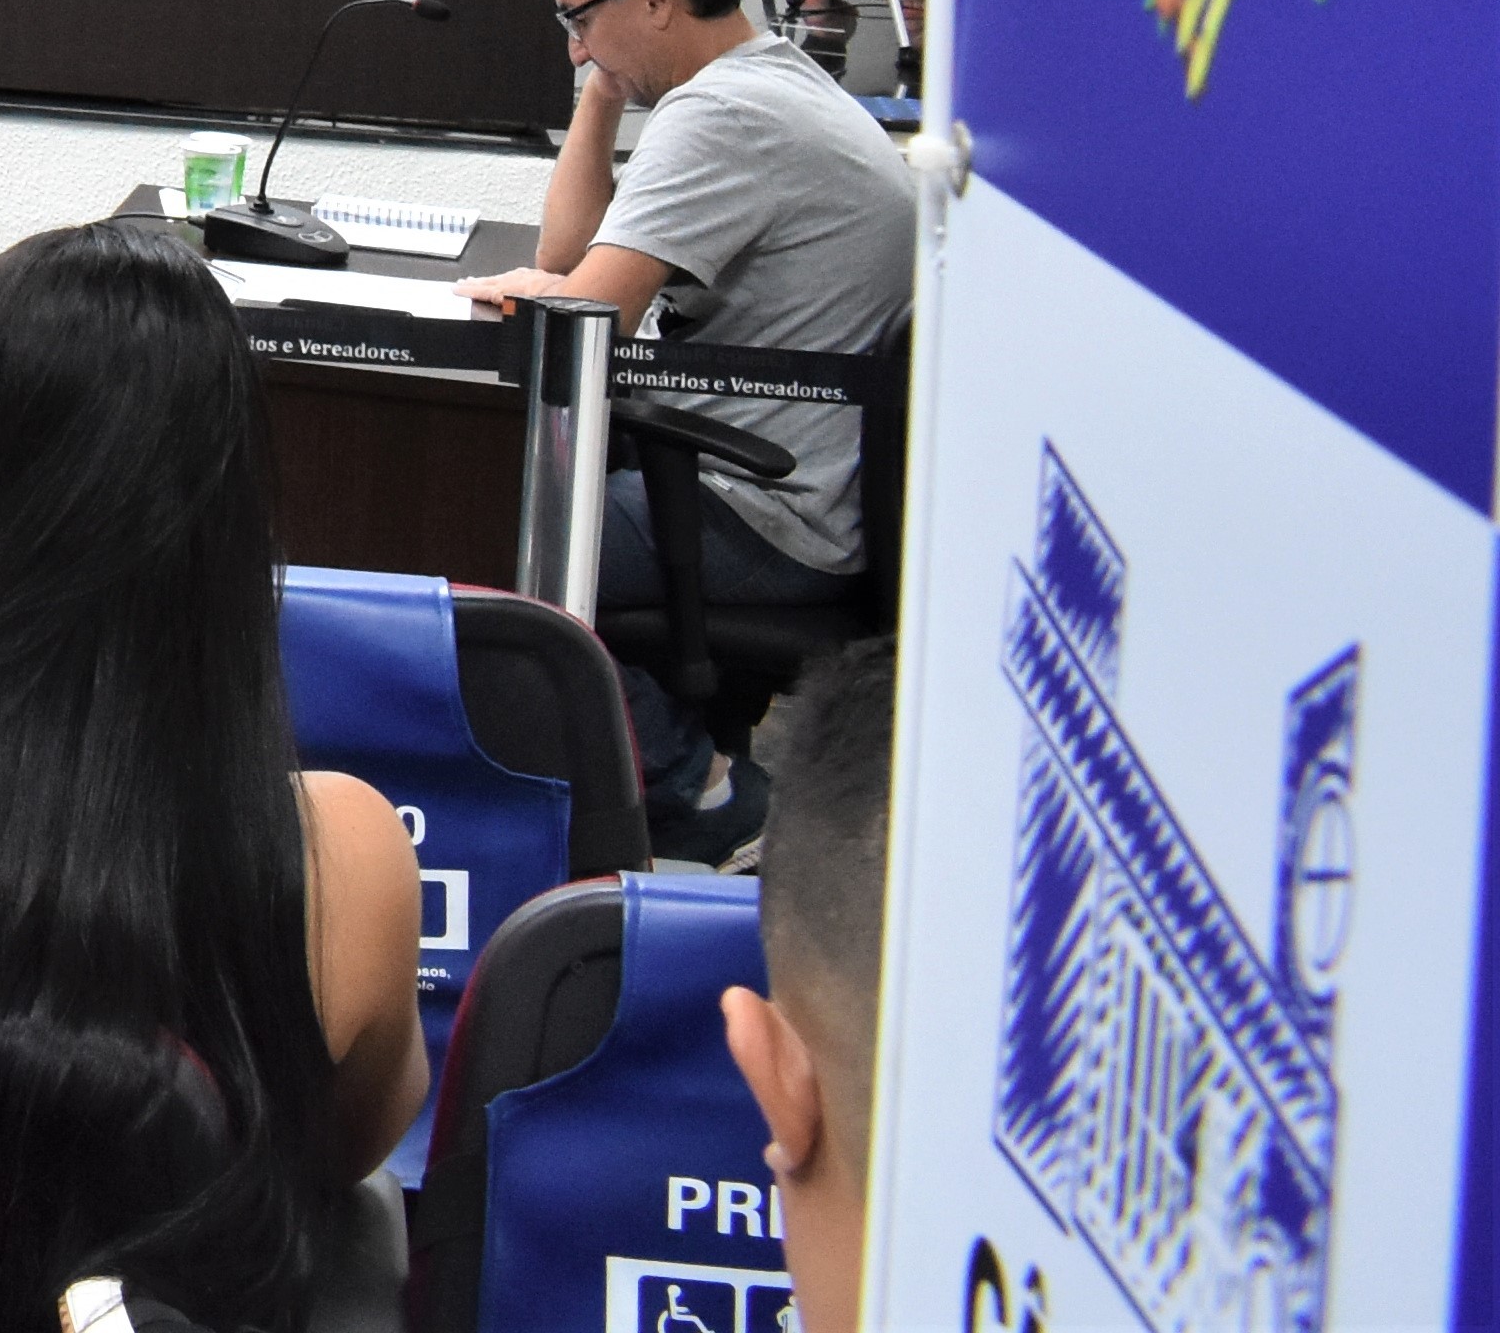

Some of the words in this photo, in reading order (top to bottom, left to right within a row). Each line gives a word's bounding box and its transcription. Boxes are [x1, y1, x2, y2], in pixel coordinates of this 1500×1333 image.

[282, 340, 294, 354] e
[298, 337, 415, 363] Vereadores.
[613, 369, 709, 392] cionários
[713, 379, 726, 392] e
[729, 376, 848, 401] Vereadores.
